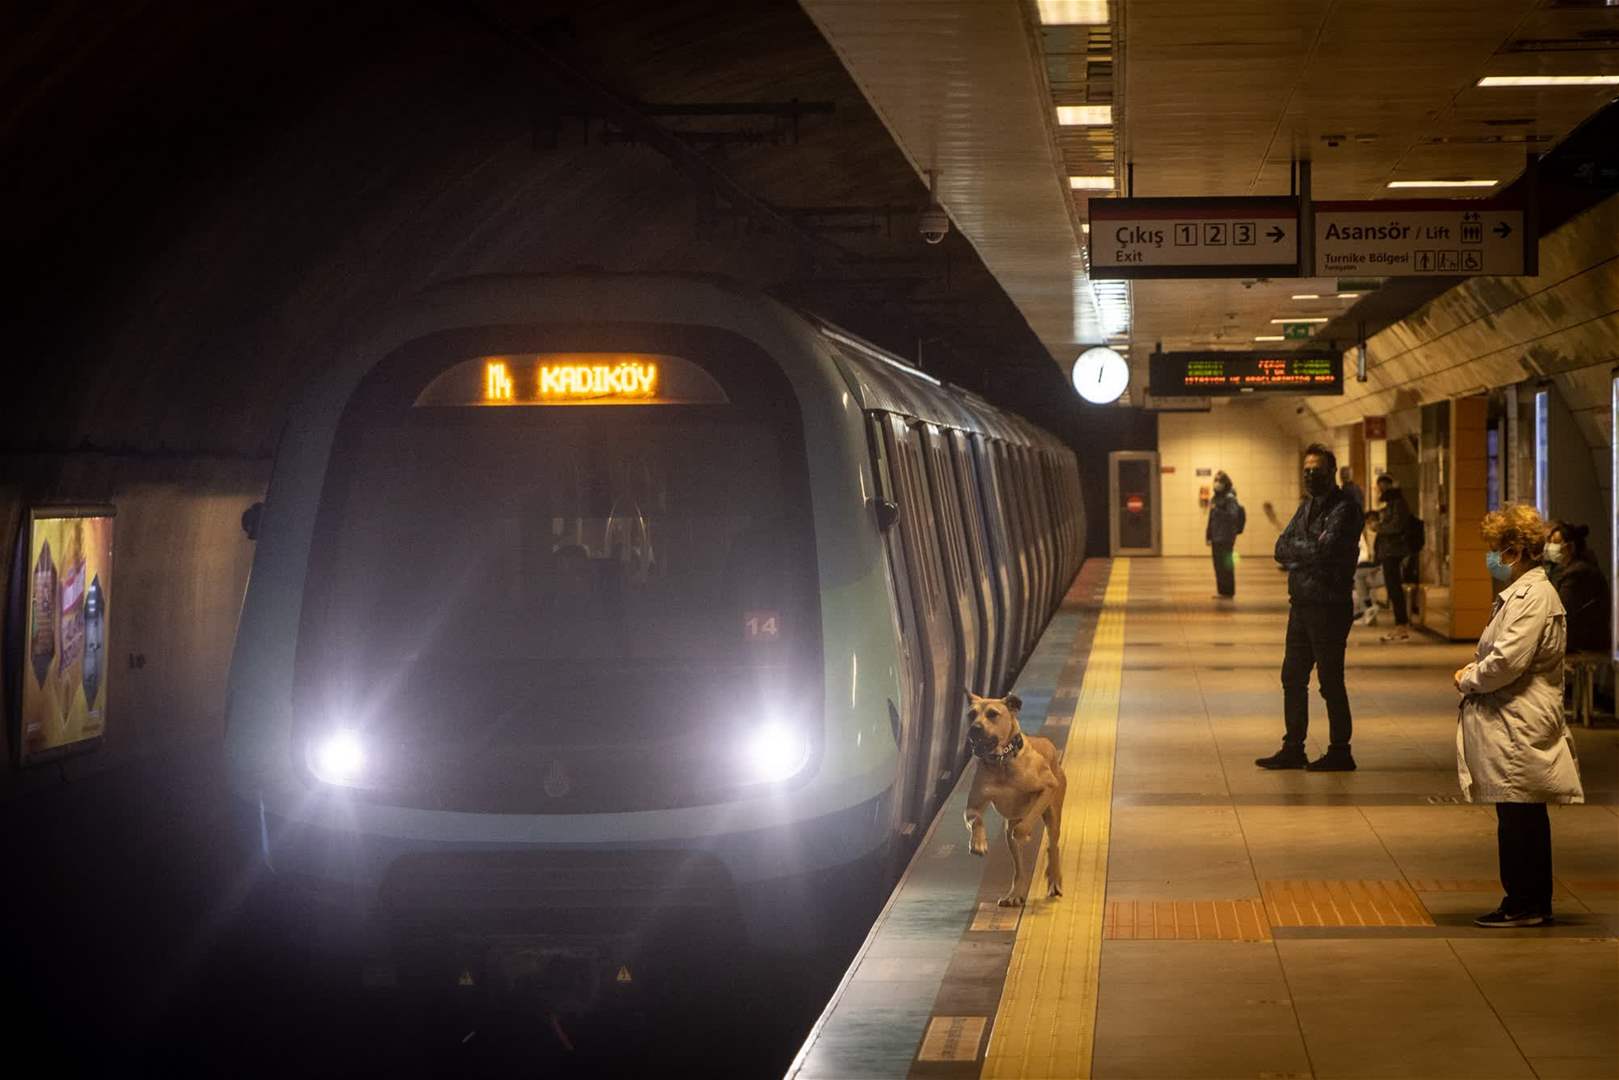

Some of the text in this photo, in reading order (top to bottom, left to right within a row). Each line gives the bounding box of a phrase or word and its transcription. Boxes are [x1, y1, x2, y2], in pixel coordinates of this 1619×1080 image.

[1115, 226, 1164, 249] Çıkış
[1325, 221, 1410, 241] Asansör
[1425, 225, 1450, 240] Lift
[1115, 250, 1143, 263] Exit
[1325, 253, 1366, 264] Turnike
[540, 362, 657, 393] KADIKÖY
[745, 617, 778, 636] 14
